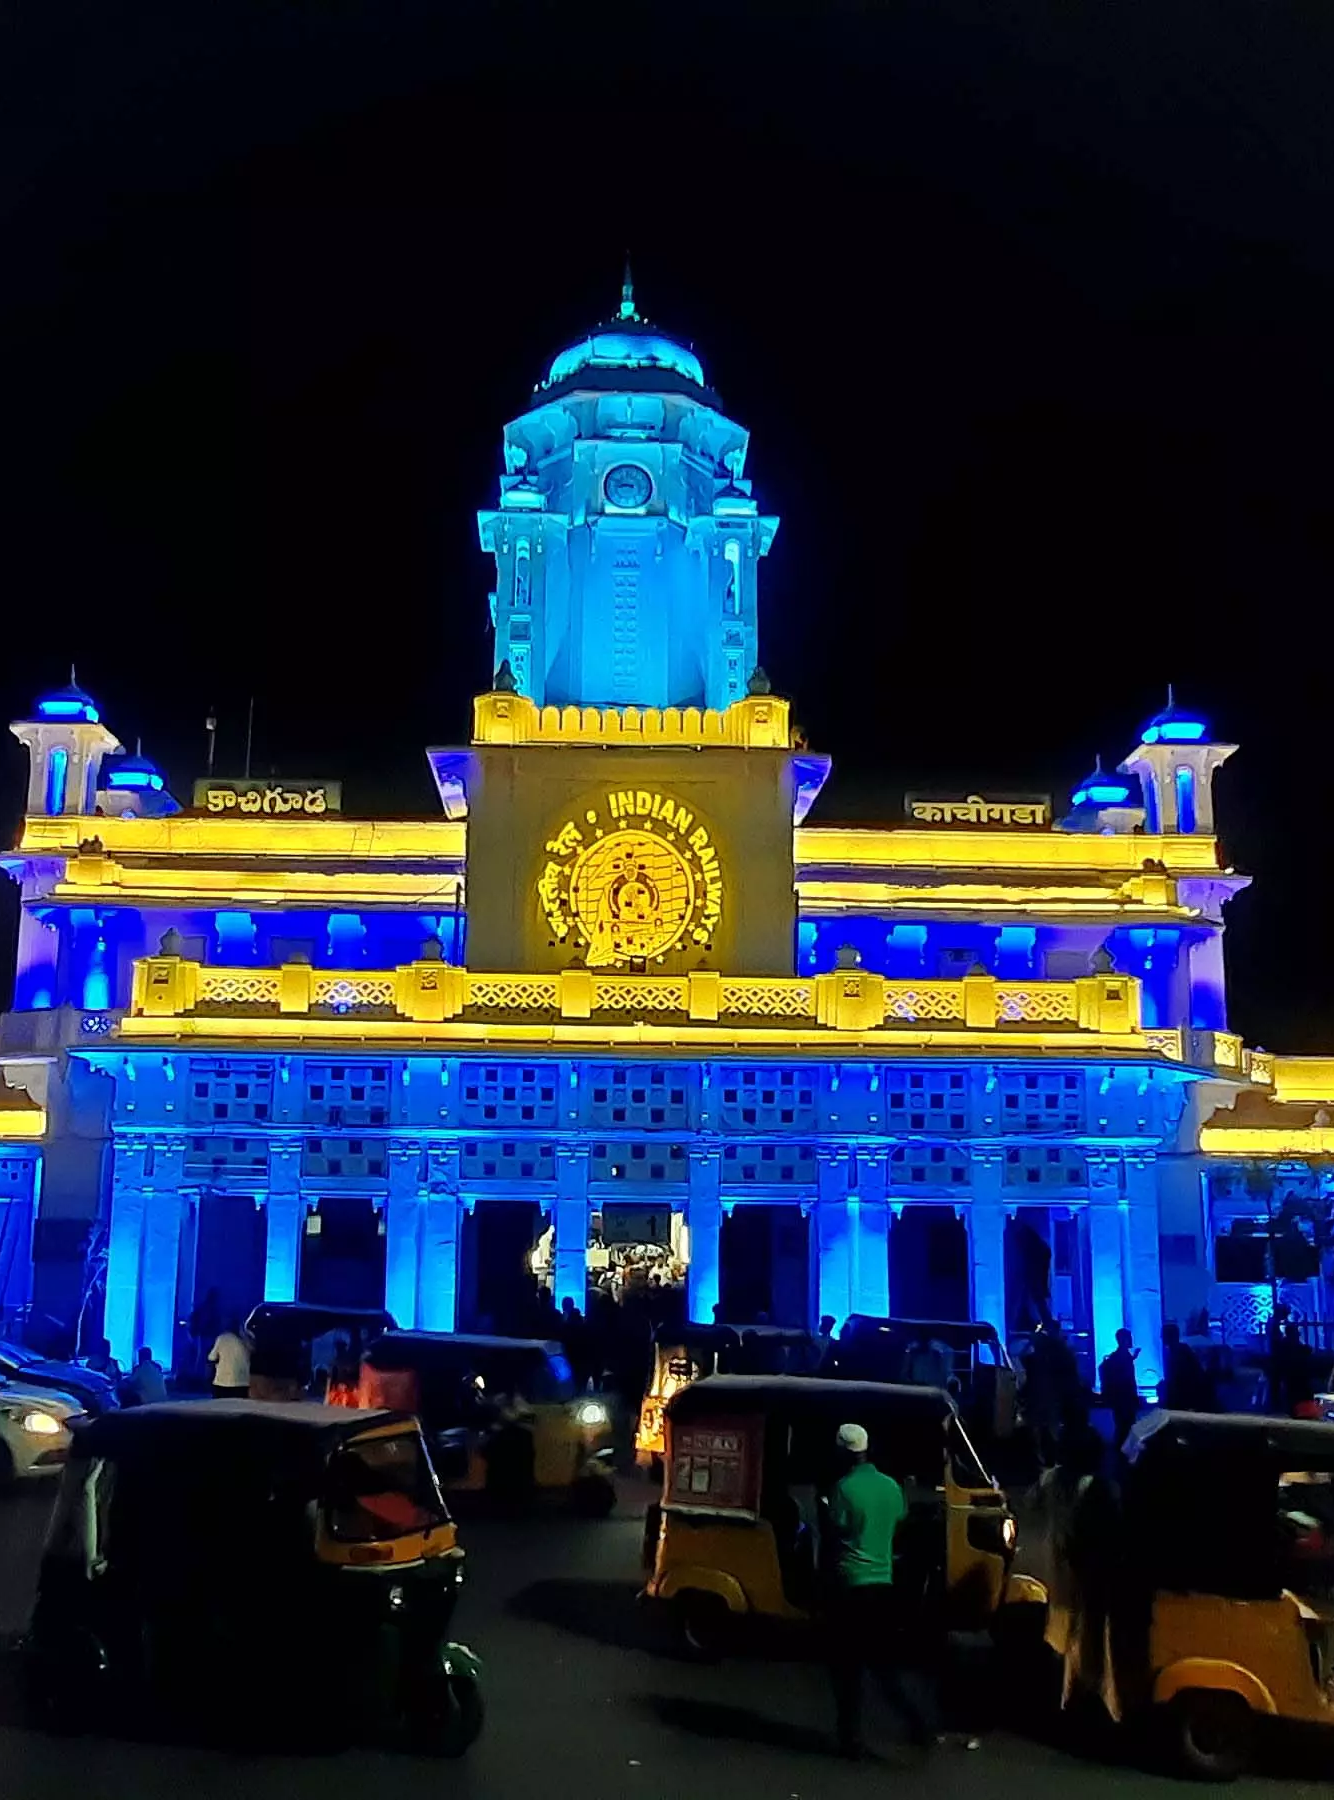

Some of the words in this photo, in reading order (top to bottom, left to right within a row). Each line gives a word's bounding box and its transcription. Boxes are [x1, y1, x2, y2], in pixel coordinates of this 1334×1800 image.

[207, 787, 327, 813] కాచిగూడ
[609, 790, 693, 834] INDIAN
[688, 826, 723, 944] RAILWAYS
